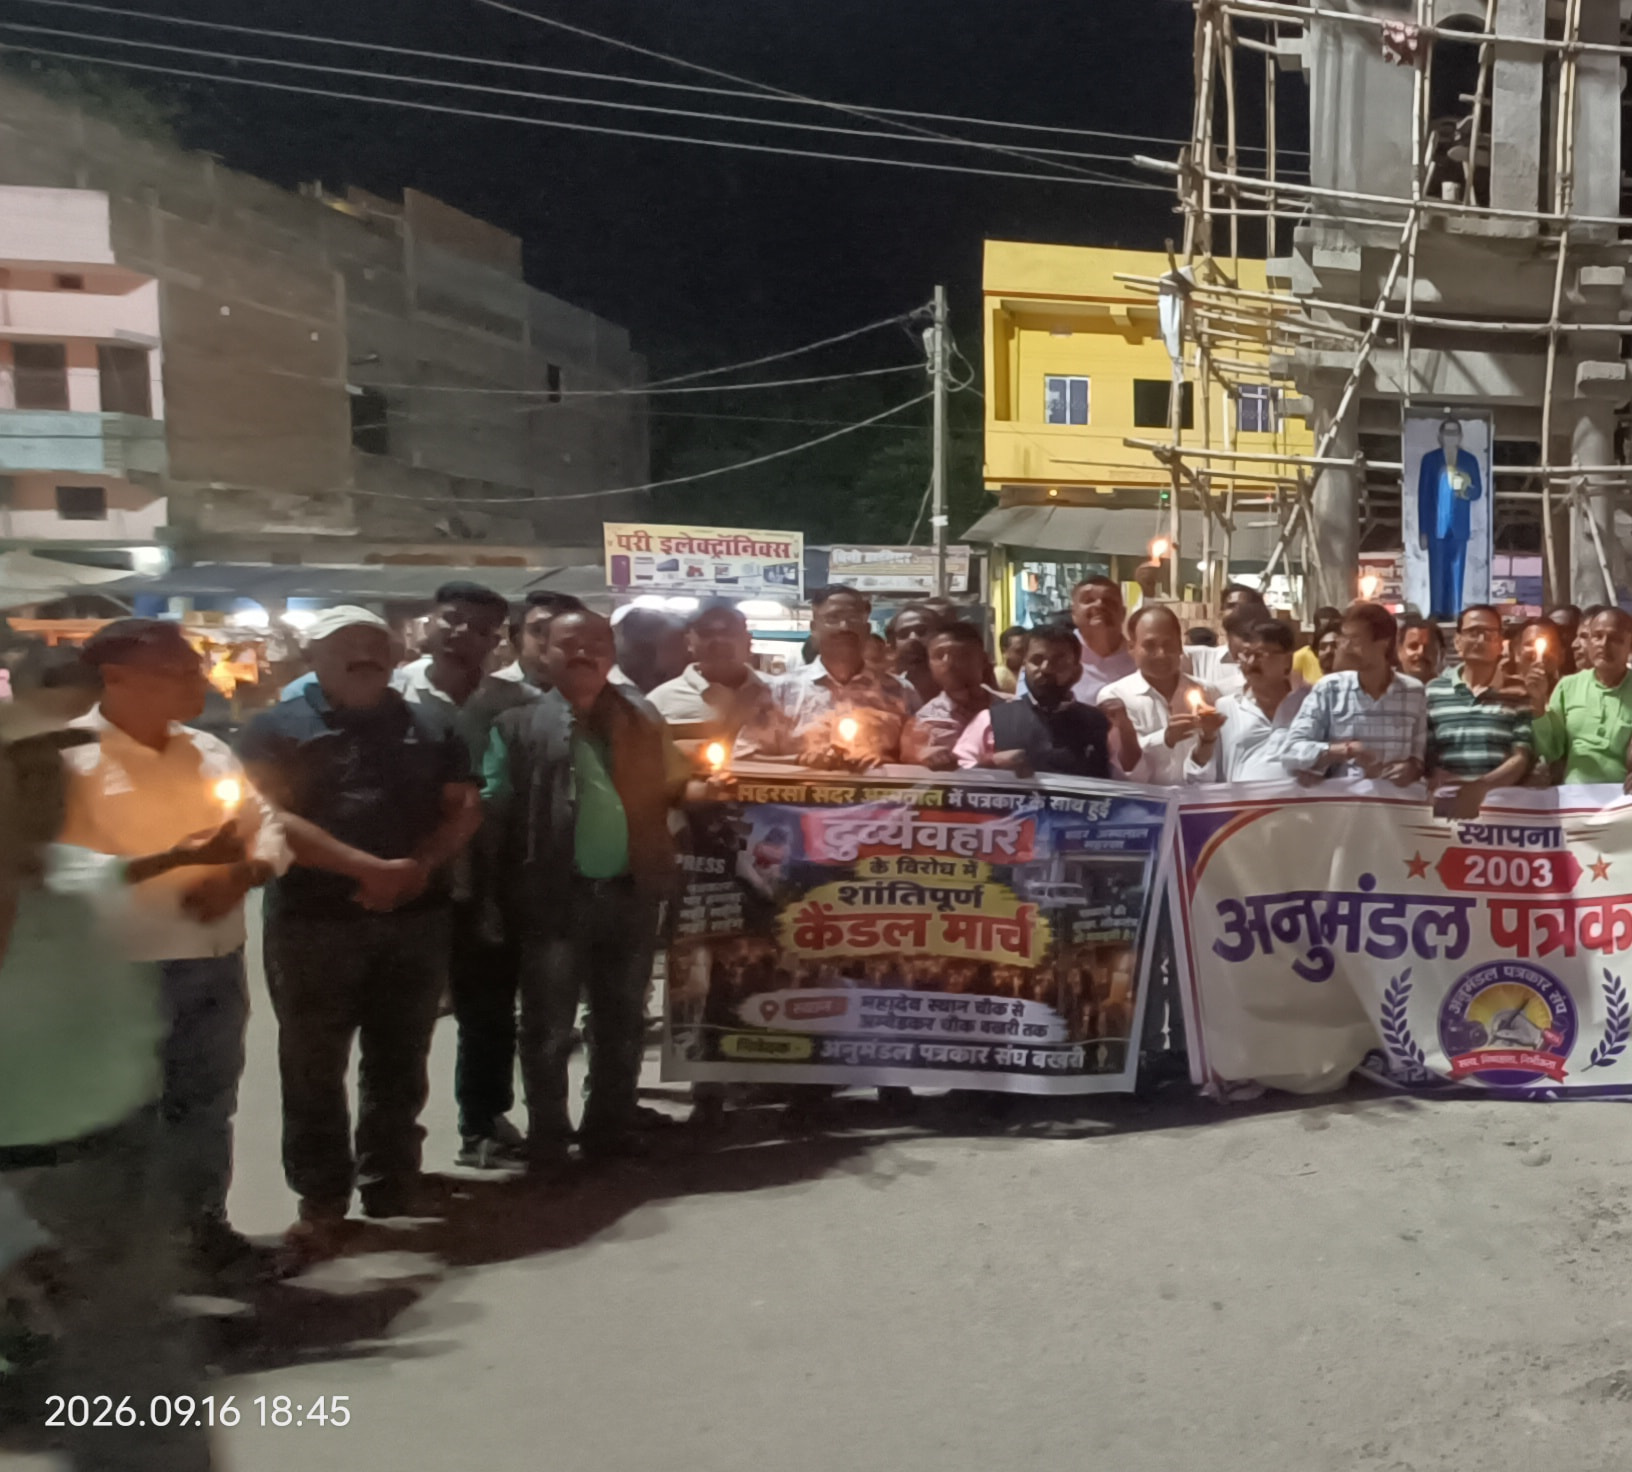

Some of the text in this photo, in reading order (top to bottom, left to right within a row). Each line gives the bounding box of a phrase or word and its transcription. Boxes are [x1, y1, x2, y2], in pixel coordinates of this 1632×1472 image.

[616, 530, 793, 559] परी इलेक्ट्रॉनिक्स
[811, 785, 855, 804] सदर
[948, 787, 963, 807] में
[968, 792, 1025, 810] पत्रकार
[1050, 795, 1085, 814] साथ
[1087, 797, 1112, 821] हुई
[1457, 821, 1562, 848] स्थापना
[870, 855, 980, 877] के विरोध में
[1463, 856, 1554, 888] 2003
[837, 880, 985, 912] शांतिपूर्ण
[793, 901, 1037, 958] कैंडल मार्च
[1212, 873, 1476, 982] अनुमंडल
[1503, 966, 1554, 992] पत्रकार
[928, 997, 970, 1014] स्थान
[1011, 1000, 1025, 1017] से
[1022, 1022, 1049, 1038] तक
[821, 1038, 1085, 1069] अनुमंडल पत्रकार संघ बखरी
